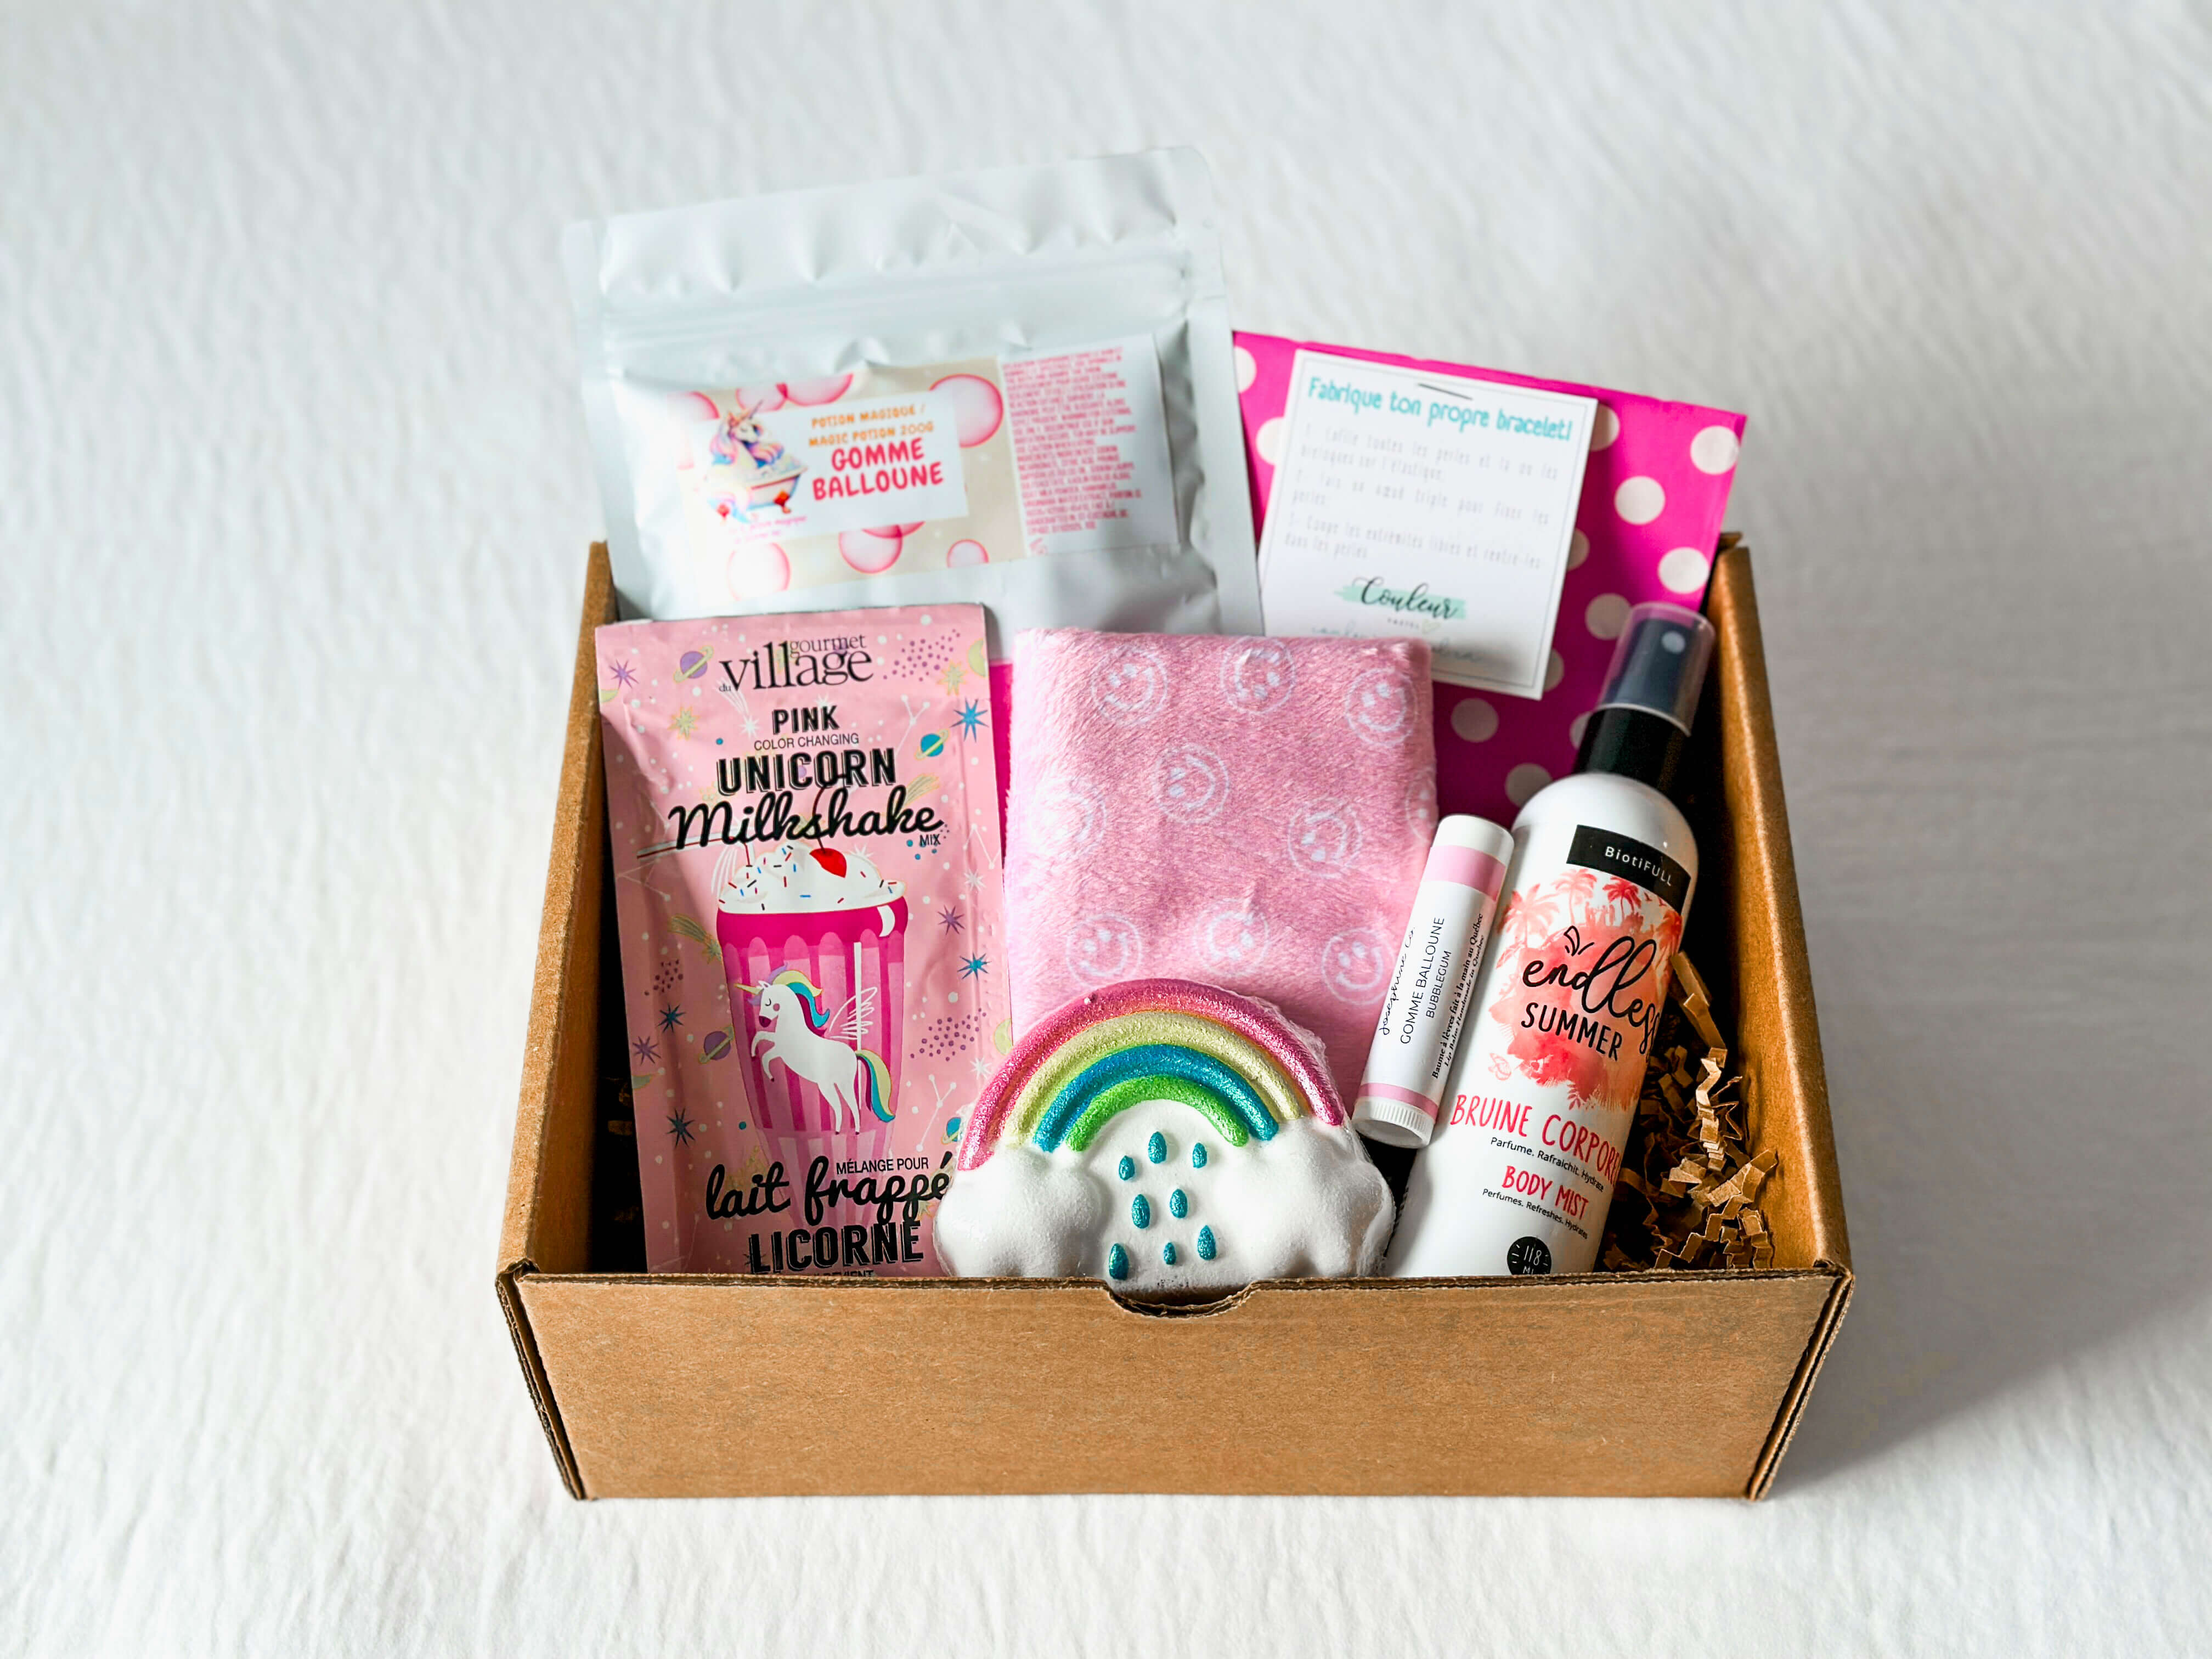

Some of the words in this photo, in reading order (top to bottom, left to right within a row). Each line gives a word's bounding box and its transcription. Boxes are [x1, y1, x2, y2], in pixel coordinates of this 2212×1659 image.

[811, 414, 854, 428] POTION
[860, 404, 915, 422] MAGIQUE
[1307, 376, 1383, 415] Fabrique
[1389, 390, 1422, 416] ton
[1427, 401, 1490, 434] propre
[809, 432, 848, 447] MAGIC
[852, 427, 896, 442] POTION
[831, 437, 924, 472] GOMME
[812, 461, 944, 501] BALLOUNE
[1351, 576, 1460, 620] Couleur
[789, 634, 867, 659] gourmet
[718, 640, 874, 692] village
[718, 683, 732, 692] du
[771, 705, 840, 736] PINK
[754, 738, 795, 751] COLOR
[797, 733, 860, 748] CHANGING
[716, 748, 897, 797] UNICORN
[668, 785, 946, 850] Milkshake
[919, 833, 942, 846] MIX
[1604, 845, 1673, 887] BiotiFULL
[1470, 913, 1483, 946] Québec
[1468, 947, 1474, 958] au
[1400, 991, 1424, 1045] GOMME
[1415, 917, 1445, 988] BALLOUNE
[1426, 950, 1452, 1019] BUBBLEGUM
[1456, 982, 1464, 991] la
[1461, 960, 1471, 981] main
[1449, 999, 1460, 1014] fait
[1442, 1015, 1455, 1040] lèvres
[1521, 1002, 1623, 1062] SUMMER
[1432, 1048, 1446, 1079] Baume
[1443, 1052, 1452, 1067] Lip
[1450, 1094, 1533, 1137] BRUINE
[1490, 1137, 1534, 1157] Parfume.
[836, 1158, 894, 1175] MÉLANGE
[897, 1157, 929, 1171] POUR
[706, 1163, 791, 1220] lait
[804, 1150, 953, 1226] frappé
[1502, 1165, 1554, 1200] BODY
[1555, 1184, 1589, 1221] MIST
[1482, 1188, 1524, 1207] Perfumes.
[1526, 1201, 1564, 1224] Refreshes.
[748, 1220, 924, 1274] LICORNE
[1523, 1245, 1542, 1266] 118
